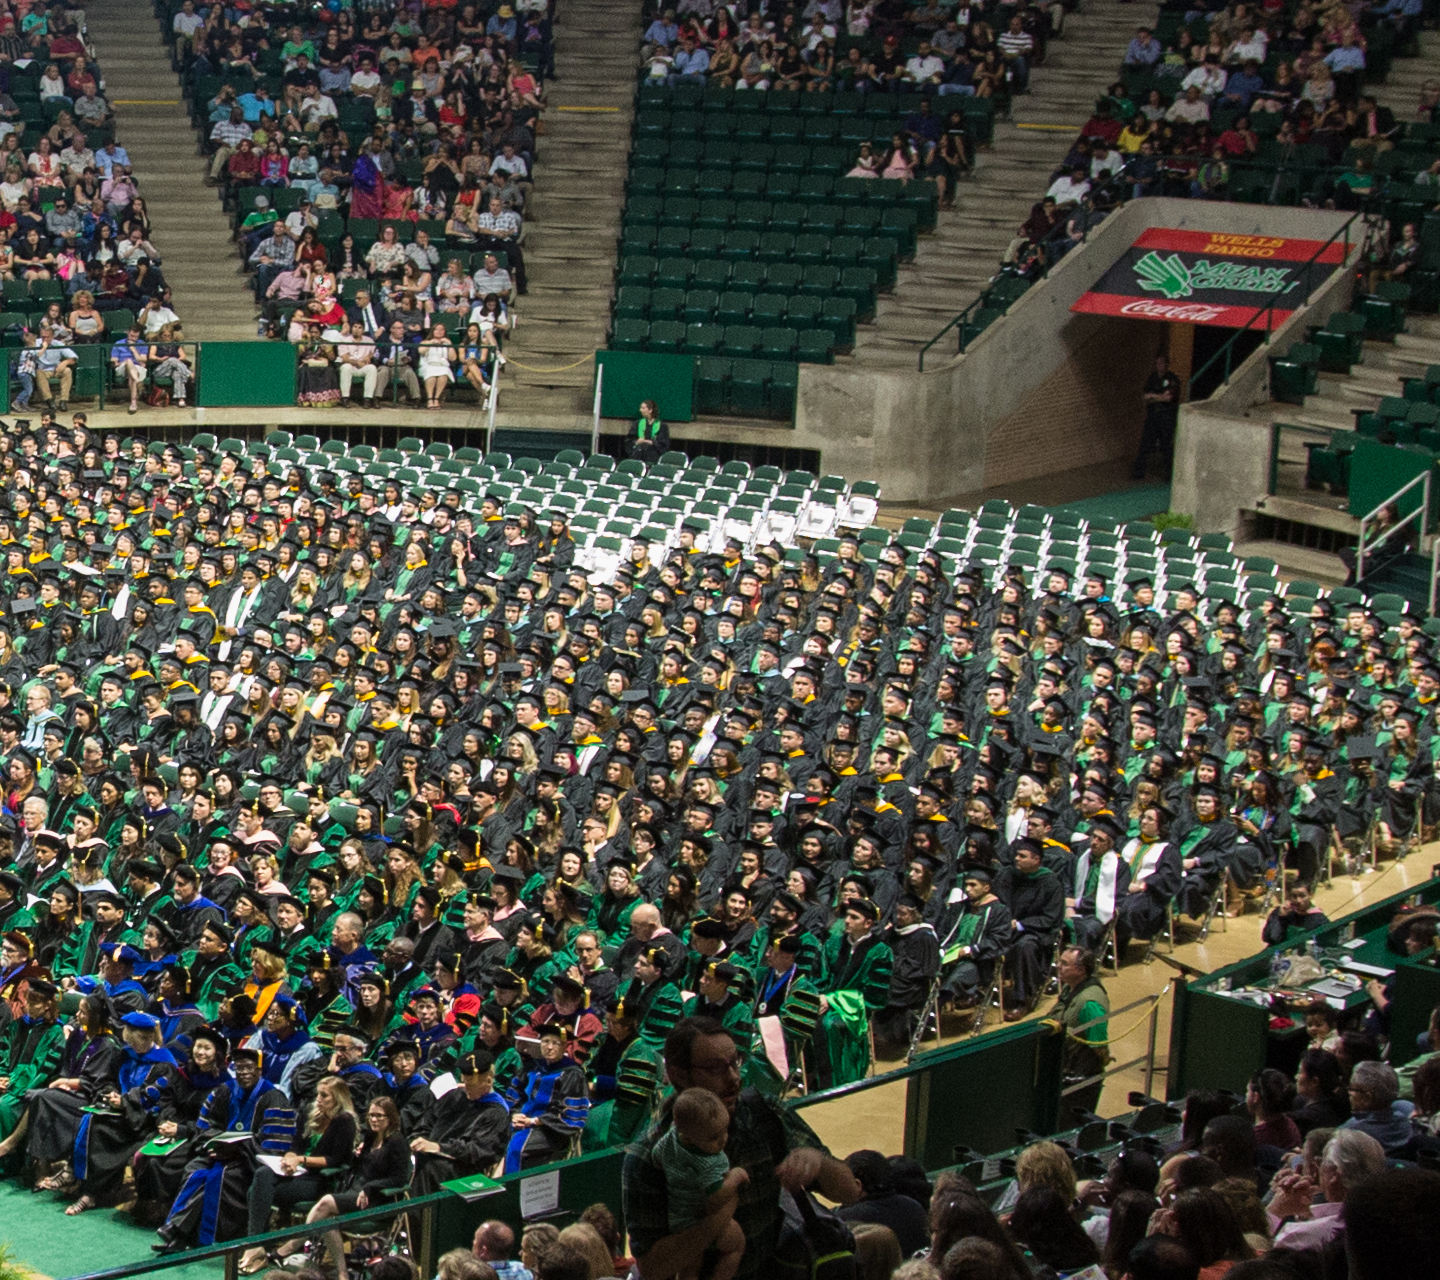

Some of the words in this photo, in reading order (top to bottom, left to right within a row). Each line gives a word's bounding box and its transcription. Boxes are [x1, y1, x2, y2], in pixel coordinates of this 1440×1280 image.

[1202, 243, 1275, 258] FARGO
[1209, 233, 1285, 249] WELLS
[1190, 259, 1293, 278] MEAN
[1191, 276, 1300, 295] GREEN
[1121, 299, 1230, 322] Coca-Cola
